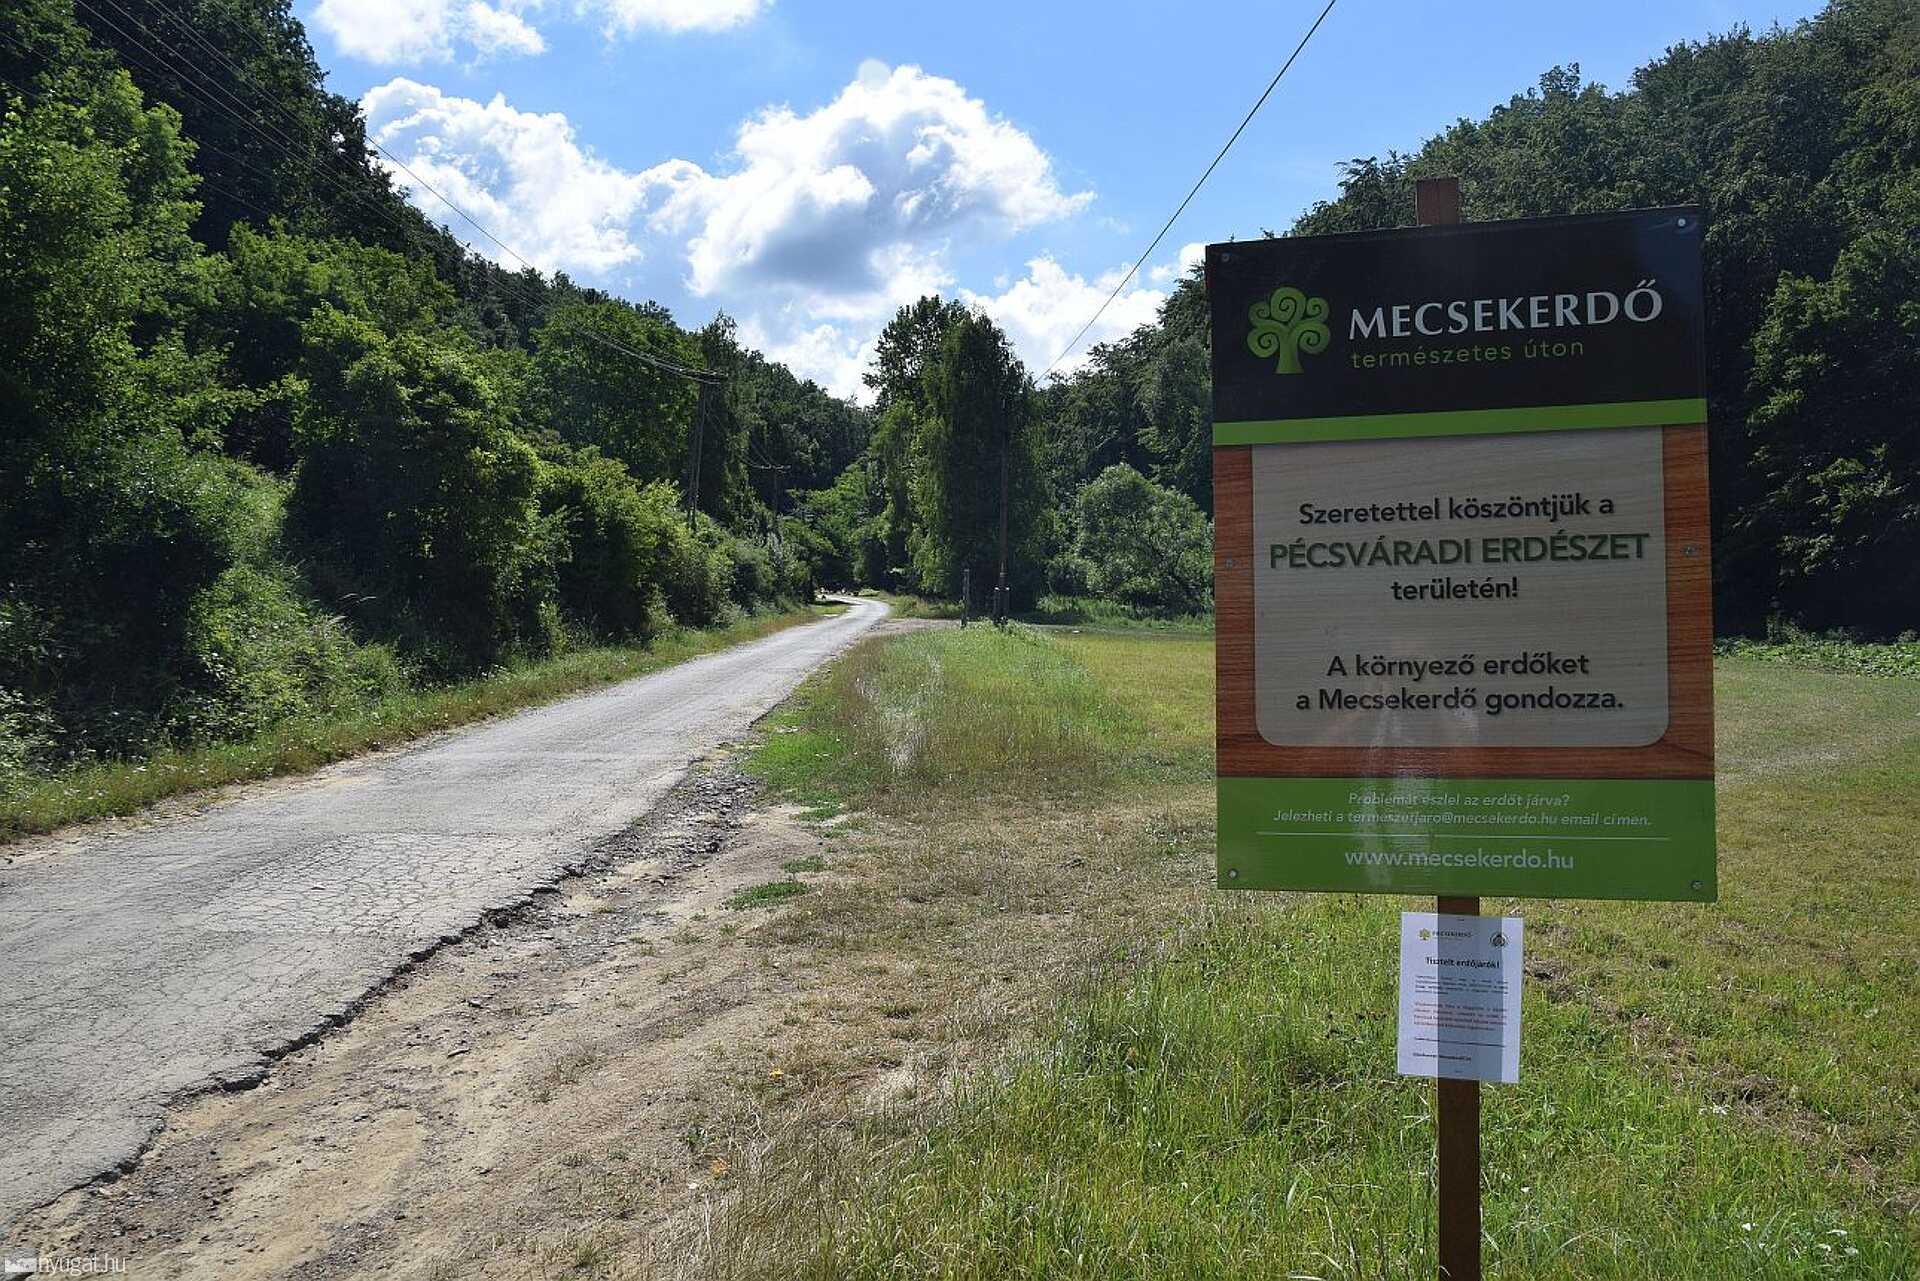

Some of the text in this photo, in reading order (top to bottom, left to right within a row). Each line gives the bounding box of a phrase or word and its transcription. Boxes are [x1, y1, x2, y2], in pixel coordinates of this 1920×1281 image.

[1349, 279, 1663, 340] MECSEKERDŐ
[1352, 338, 1584, 369] természetes úton
[1299, 493, 1614, 524] Szeretettel köszöntjük a
[1270, 529, 1650, 568] PÉCSVÁRADI ERDÉSZET
[1391, 577, 1518, 601] területén!
[1327, 652, 1589, 681] A környező erdőket
[1296, 686, 1623, 714] a Mecsekerdő gondozza.
[1464, 796, 1479, 806] az
[1525, 794, 1570, 808] járva?
[1273, 809, 1332, 822] Jelezheti
[1336, 811, 1344, 822] a
[1561, 811, 1600, 825] email
[1344, 848, 1575, 870] www.mecsekerdo.hu
